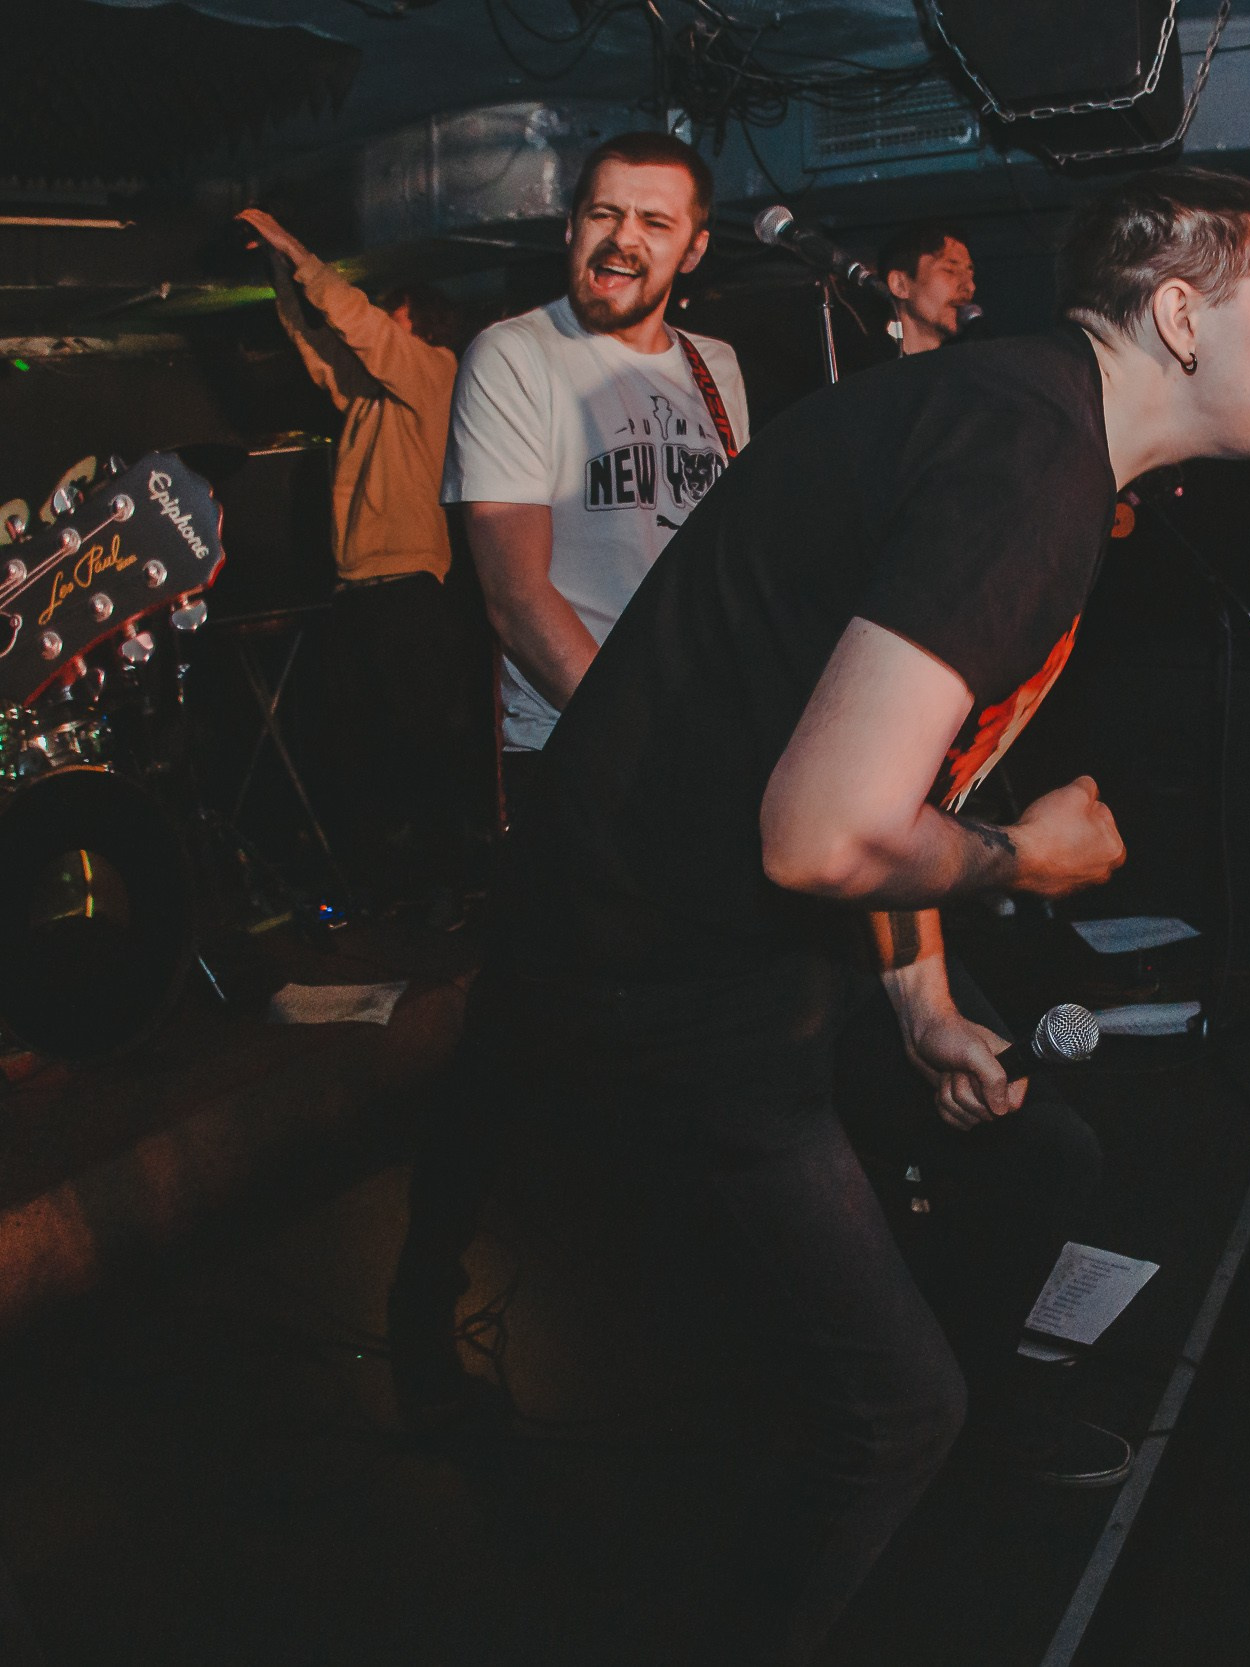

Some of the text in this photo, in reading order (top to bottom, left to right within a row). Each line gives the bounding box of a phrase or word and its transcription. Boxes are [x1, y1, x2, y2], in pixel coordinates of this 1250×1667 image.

[590, 445, 656, 506] NEW
[149, 470, 209, 560] Epiphone
[73, 534, 121, 587] Paul
